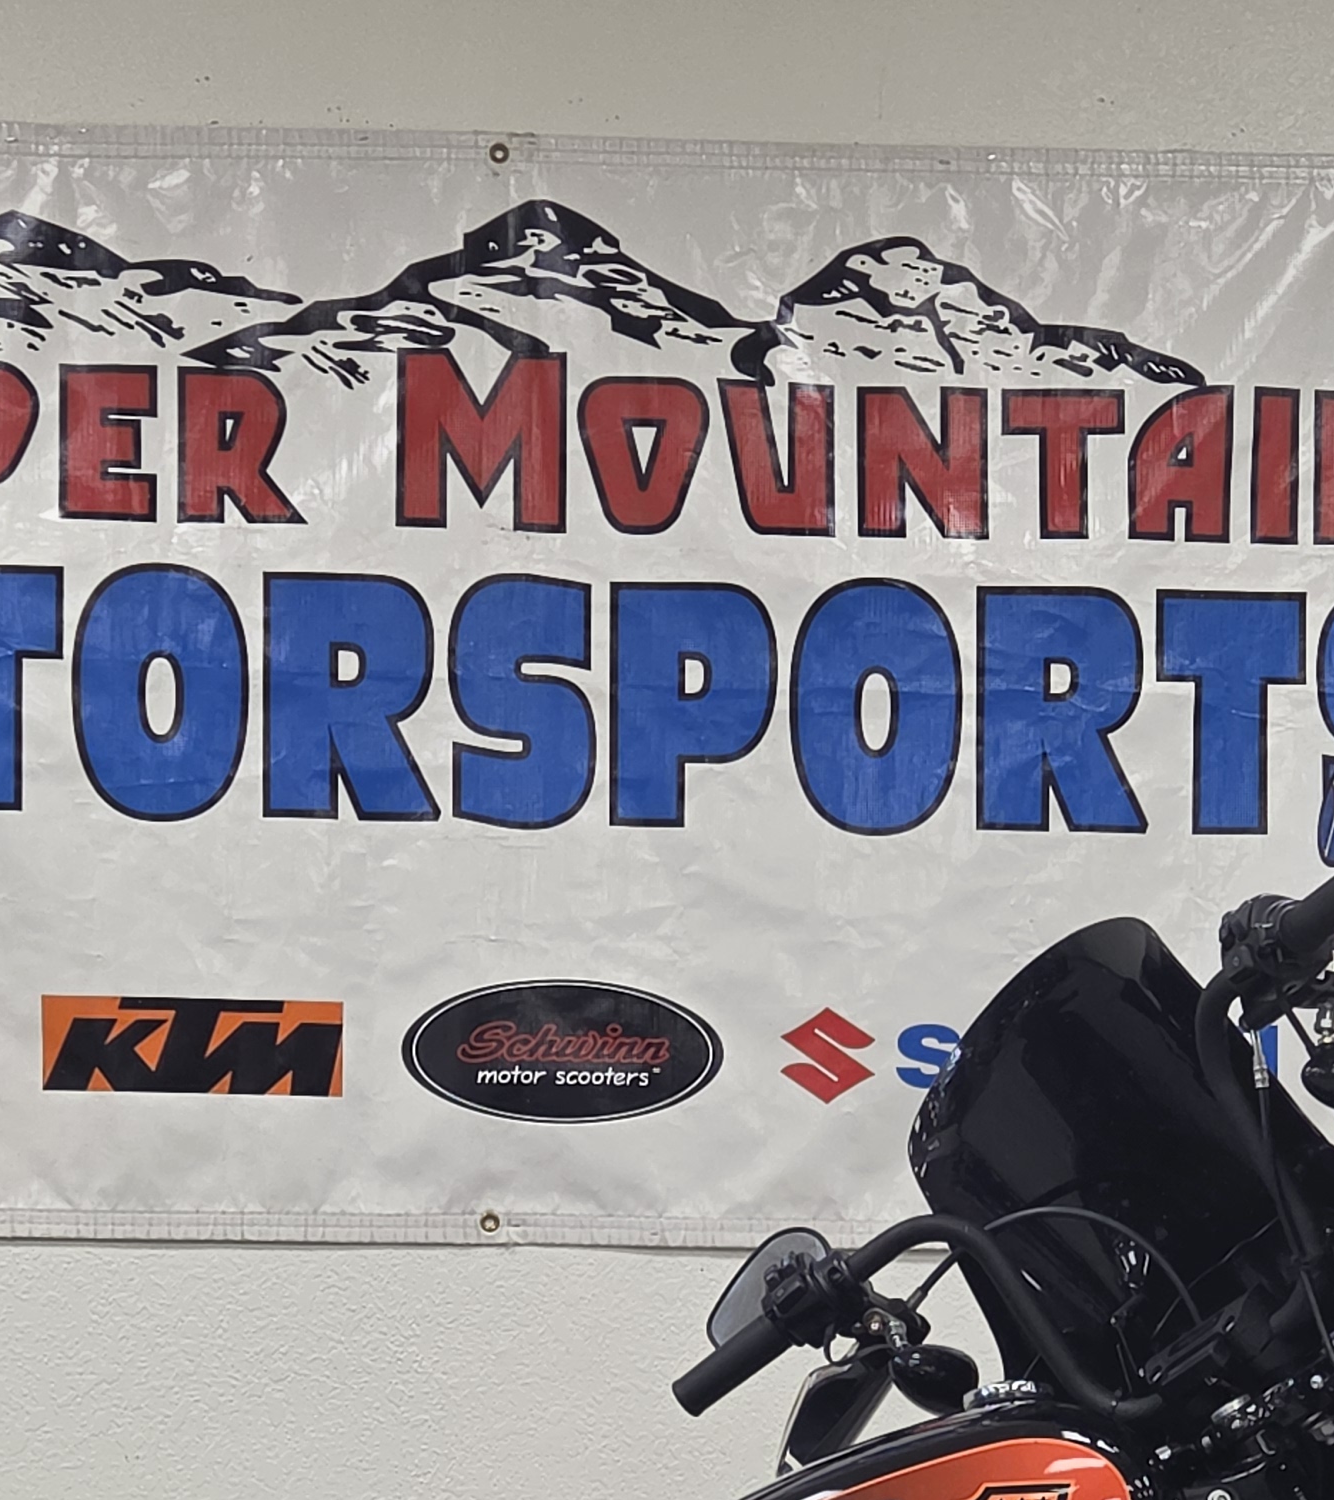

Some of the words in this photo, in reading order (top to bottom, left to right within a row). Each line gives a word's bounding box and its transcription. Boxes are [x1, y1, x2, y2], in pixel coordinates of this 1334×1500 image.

[42, 997, 343, 1097] KTM
[457, 1020, 671, 1065] Schwinn
[476, 1065, 547, 1085] motor
[554, 1067, 650, 1087] scooters
